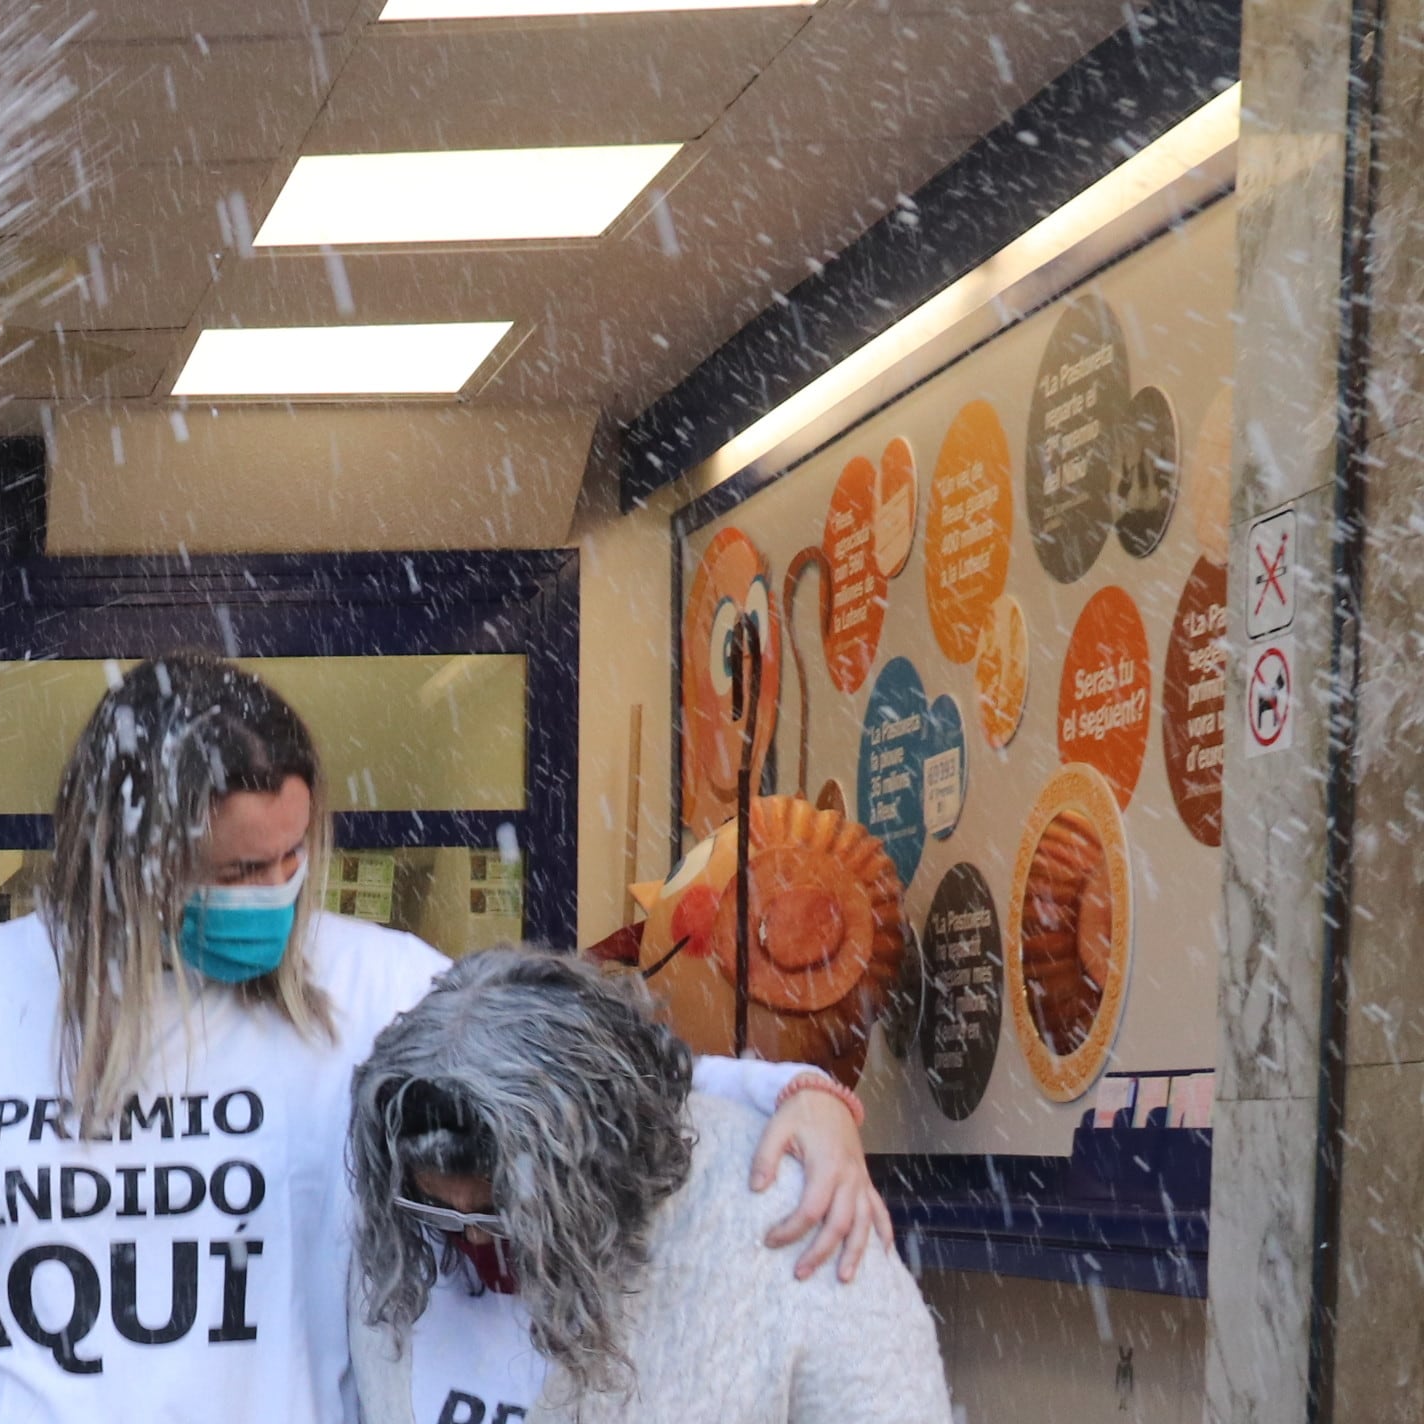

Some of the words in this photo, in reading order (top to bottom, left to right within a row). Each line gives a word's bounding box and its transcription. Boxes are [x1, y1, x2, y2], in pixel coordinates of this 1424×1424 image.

[1074, 662, 1116, 700] Seràs
[1118, 654, 1135, 686] tu
[1062, 709, 1077, 742] el
[1079, 687, 1146, 741] següent?
